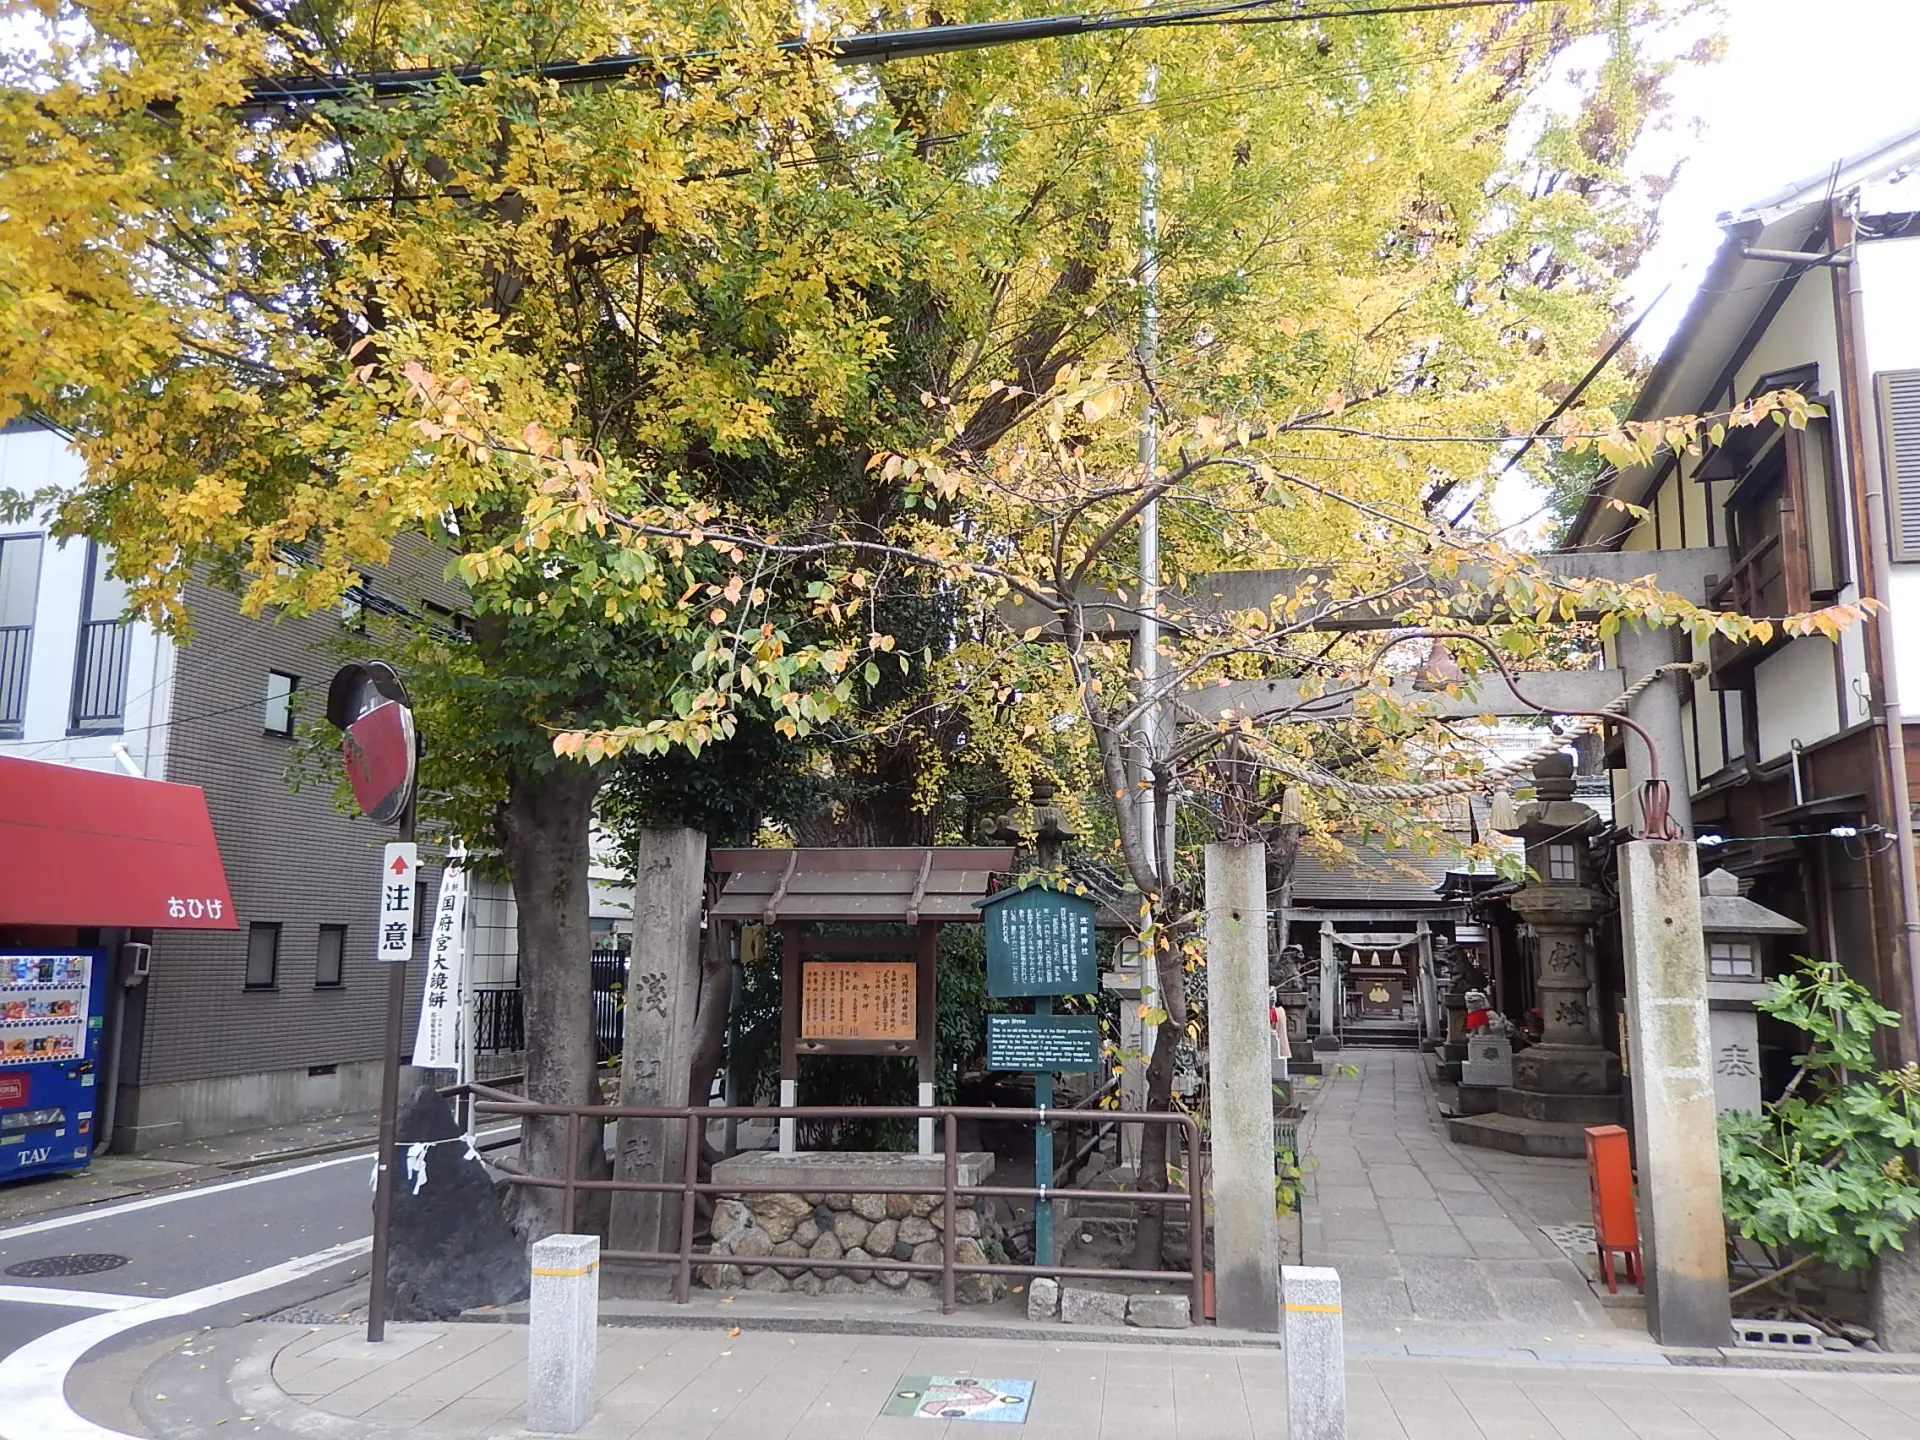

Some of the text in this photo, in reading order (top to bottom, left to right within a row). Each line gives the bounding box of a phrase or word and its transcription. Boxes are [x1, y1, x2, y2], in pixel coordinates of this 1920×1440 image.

[167, 895, 223, 921] おひげ
[382, 883, 410, 951] 注意
